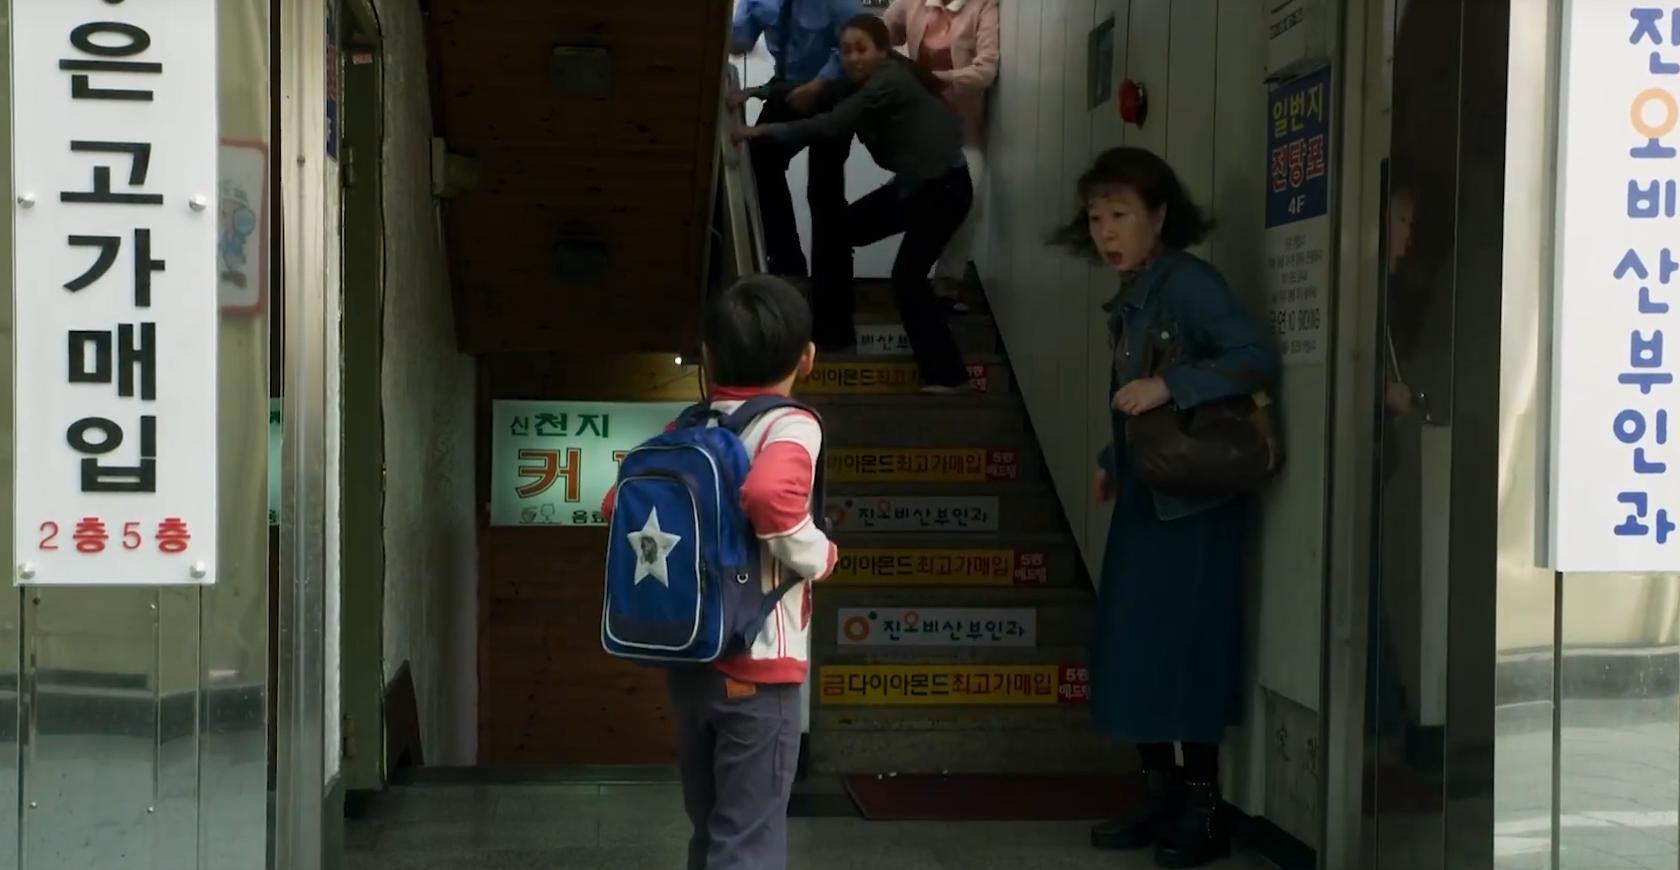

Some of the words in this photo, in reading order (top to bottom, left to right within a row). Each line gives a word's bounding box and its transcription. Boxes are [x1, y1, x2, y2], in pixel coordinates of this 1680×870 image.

[1272, 83, 1324, 138] 일번지
[1271, 133, 1325, 193] 전당포
[1287, 194, 1306, 215] 4F
[510, 412, 610, 438] 신천지
